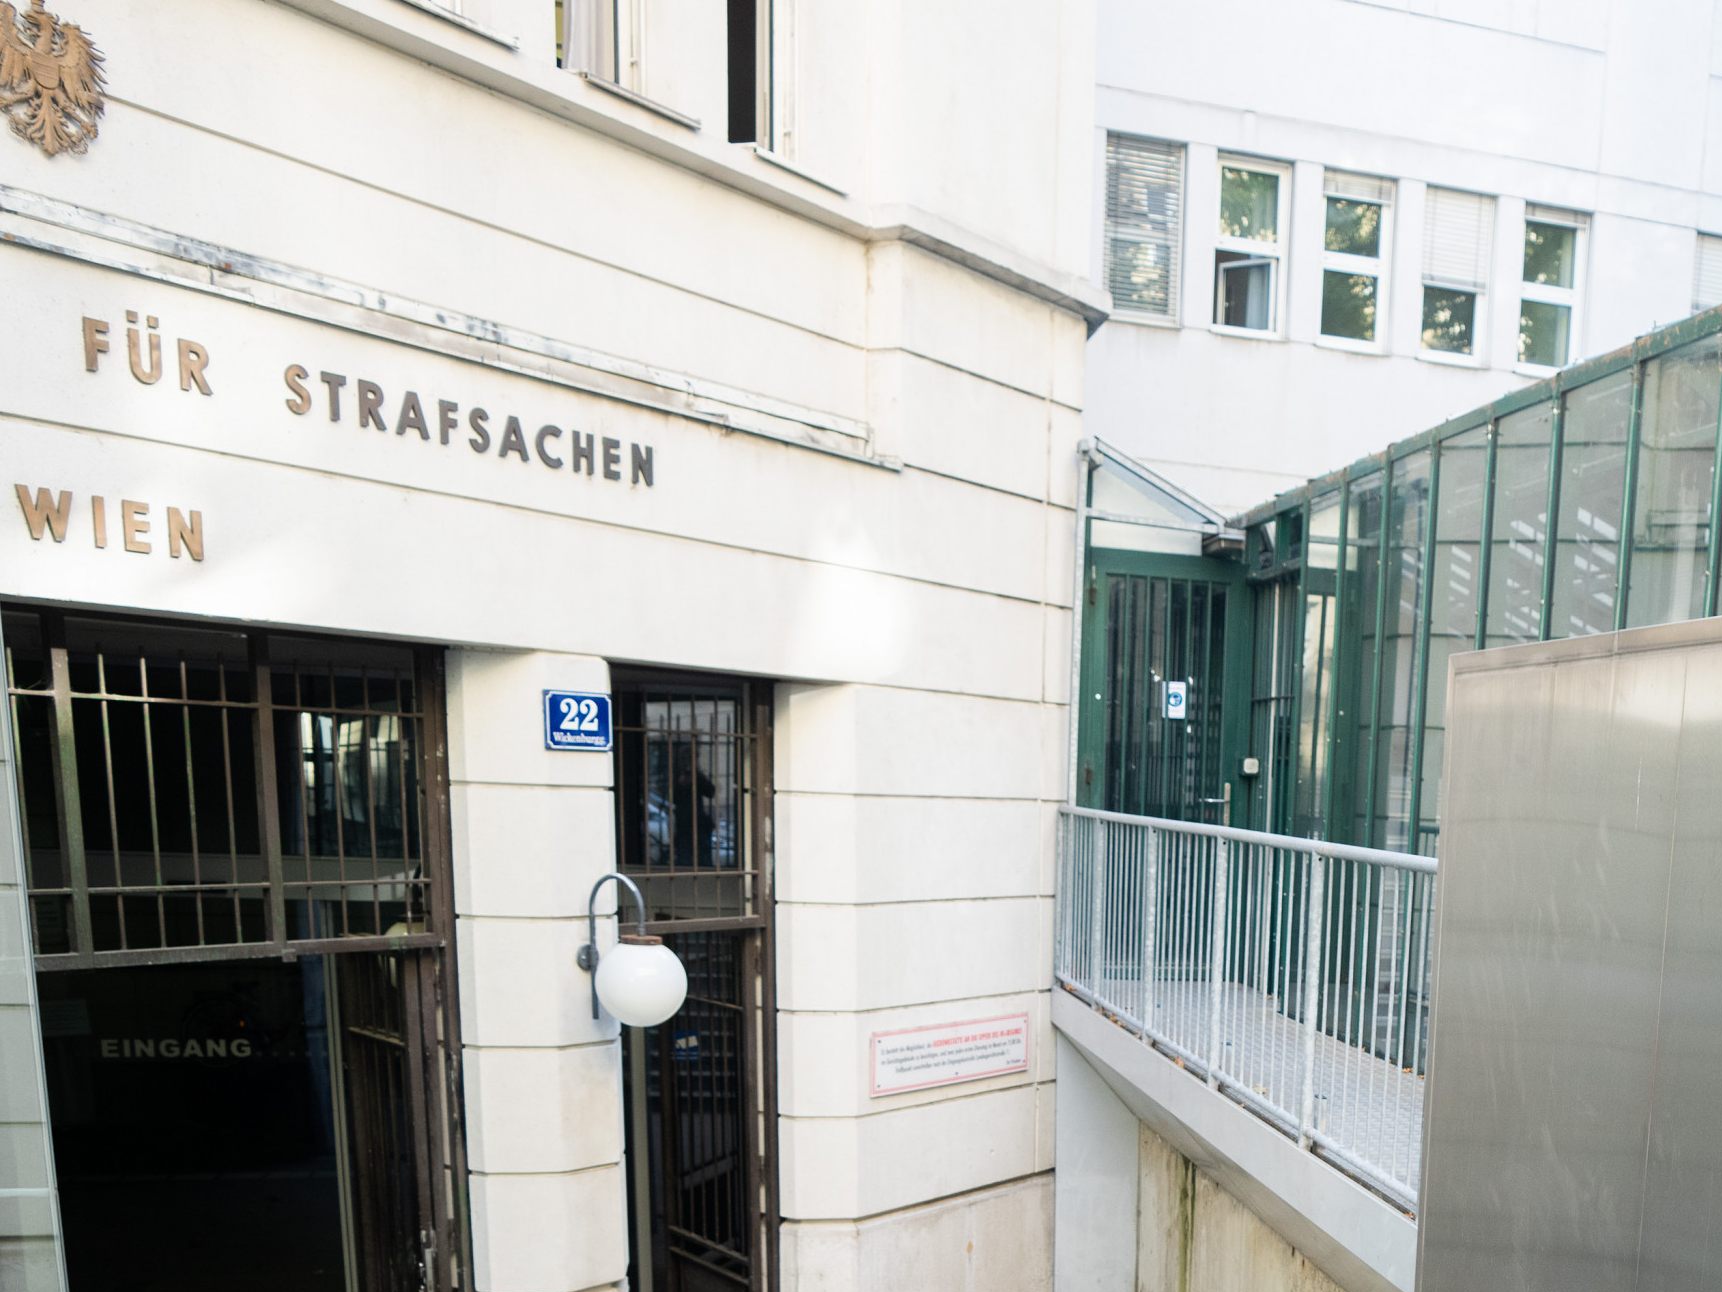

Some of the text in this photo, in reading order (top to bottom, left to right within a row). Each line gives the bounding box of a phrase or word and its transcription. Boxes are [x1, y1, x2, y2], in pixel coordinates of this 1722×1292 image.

[82, 310, 655, 487] FÜR STRAFSACHEN
[14, 484, 205, 562] WIEN
[560, 698, 599, 731] 22
[101, 1039, 251, 1058] EINGANG
